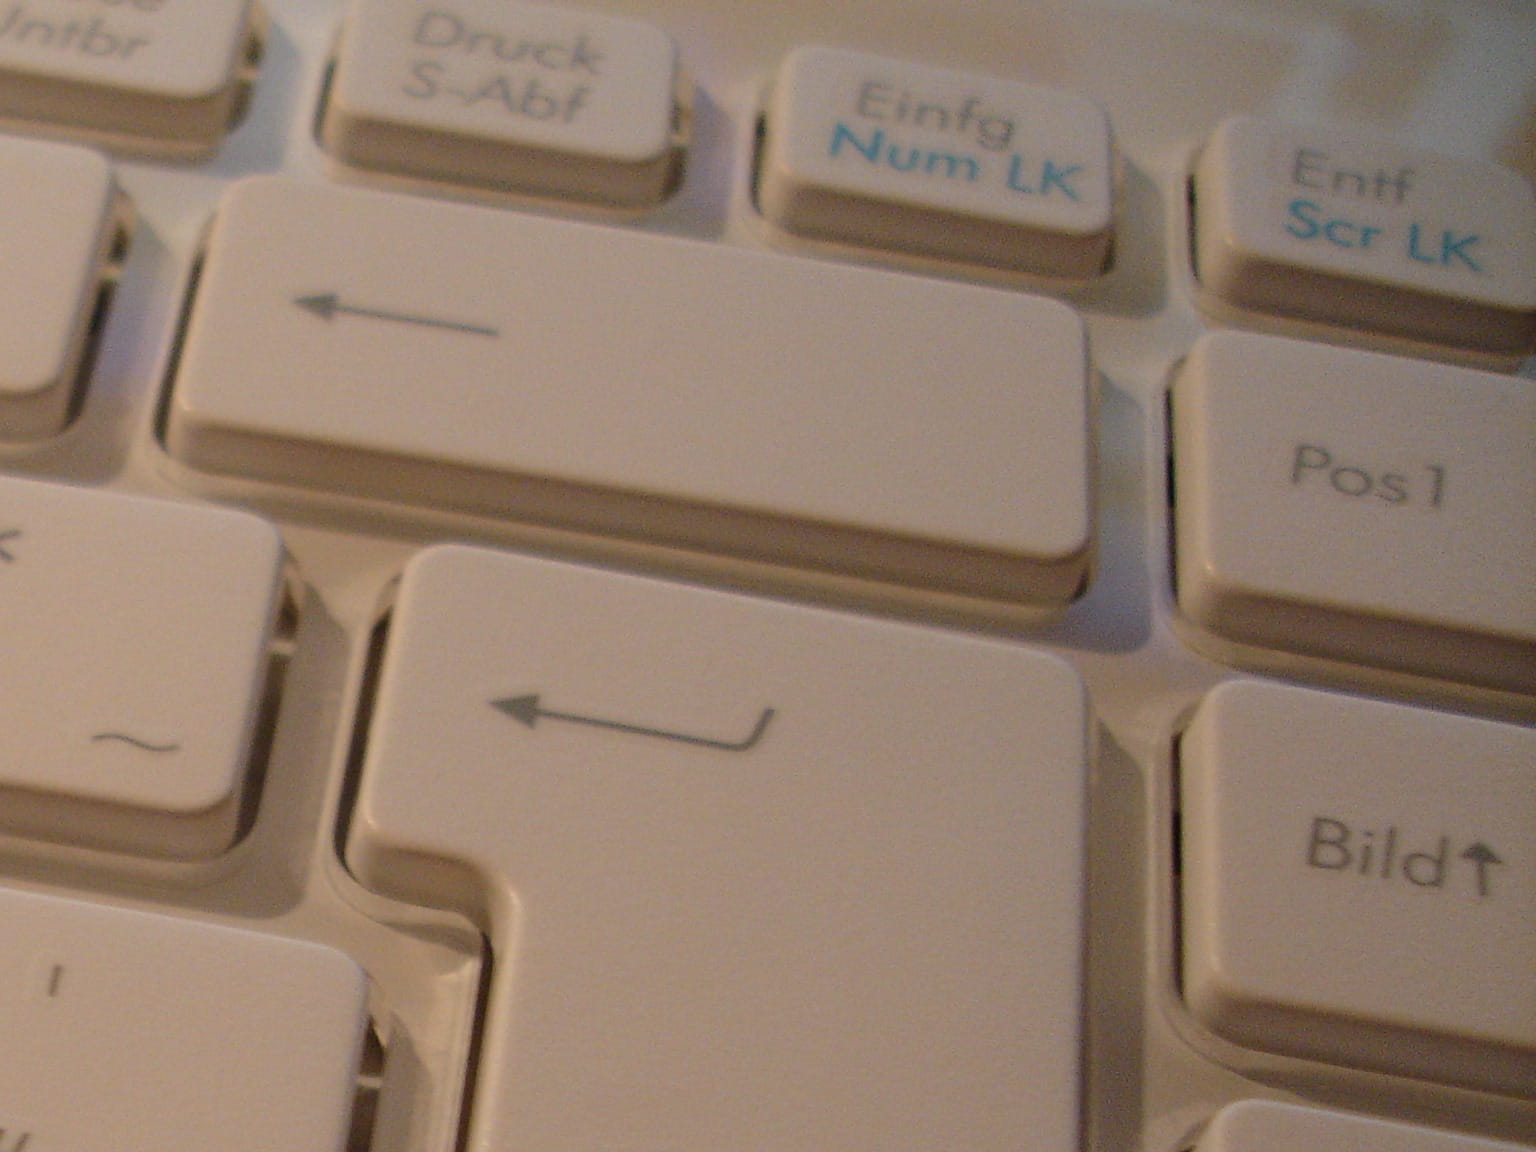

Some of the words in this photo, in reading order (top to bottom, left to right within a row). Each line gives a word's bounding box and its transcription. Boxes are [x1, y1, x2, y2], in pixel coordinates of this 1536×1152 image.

[414, 10, 604, 75] Druck
[402, 60, 592, 123] S-Abf
[855, 80, 1014, 152] Einfg
[828, 122, 980, 184] Num
[1005, 154, 1083, 201] LK
[1291, 148, 1415, 203] Entf
[1284, 200, 1380, 252] Scr
[1407, 223, 1484, 271] LK
[1290, 443, 1448, 507] Pos1
[1306, 816, 1452, 890] Bild
